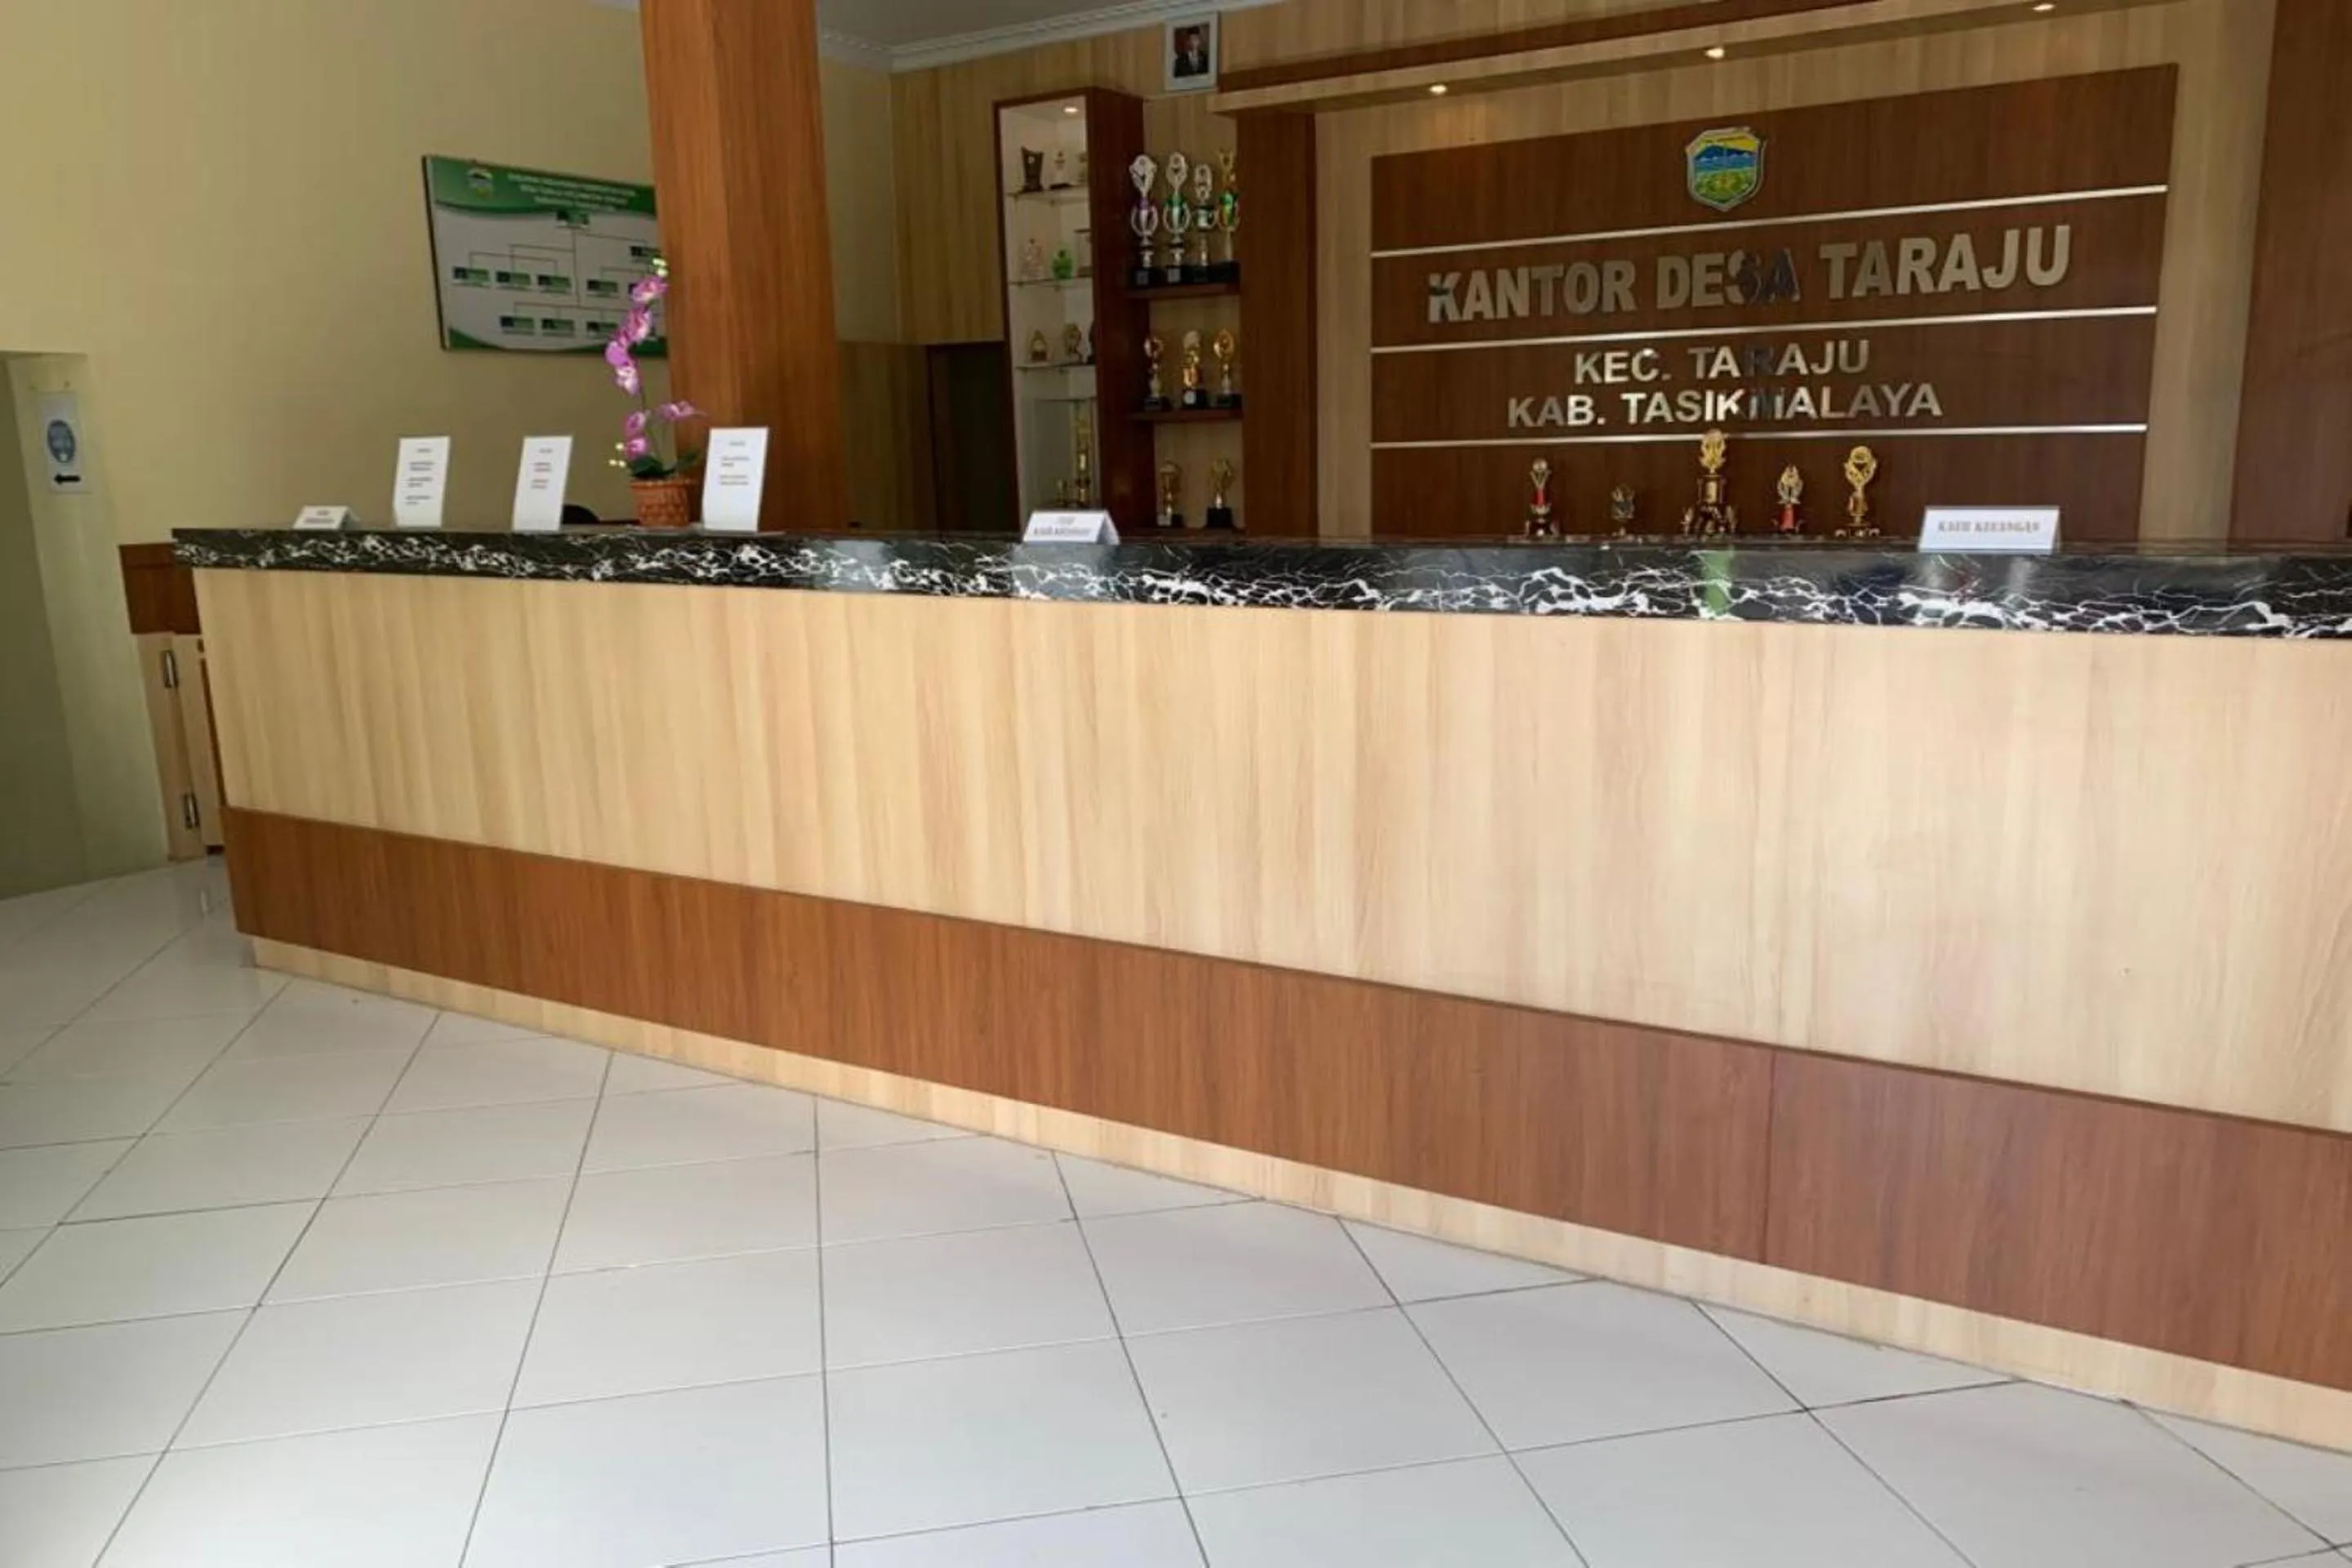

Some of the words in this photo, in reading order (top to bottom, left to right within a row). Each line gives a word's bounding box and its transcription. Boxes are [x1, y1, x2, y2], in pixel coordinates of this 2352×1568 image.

[1428, 260, 1637, 323] KANTOR
[1656, 248, 1800, 310] DESA
[1819, 225, 2071, 300] TARAJU
[1574, 347, 1672, 384] KEC.
[1687, 340, 1870, 379] TARAJU
[1508, 393, 1606, 428] KAB.
[1620, 382, 1943, 425] TASIKMALAYA
